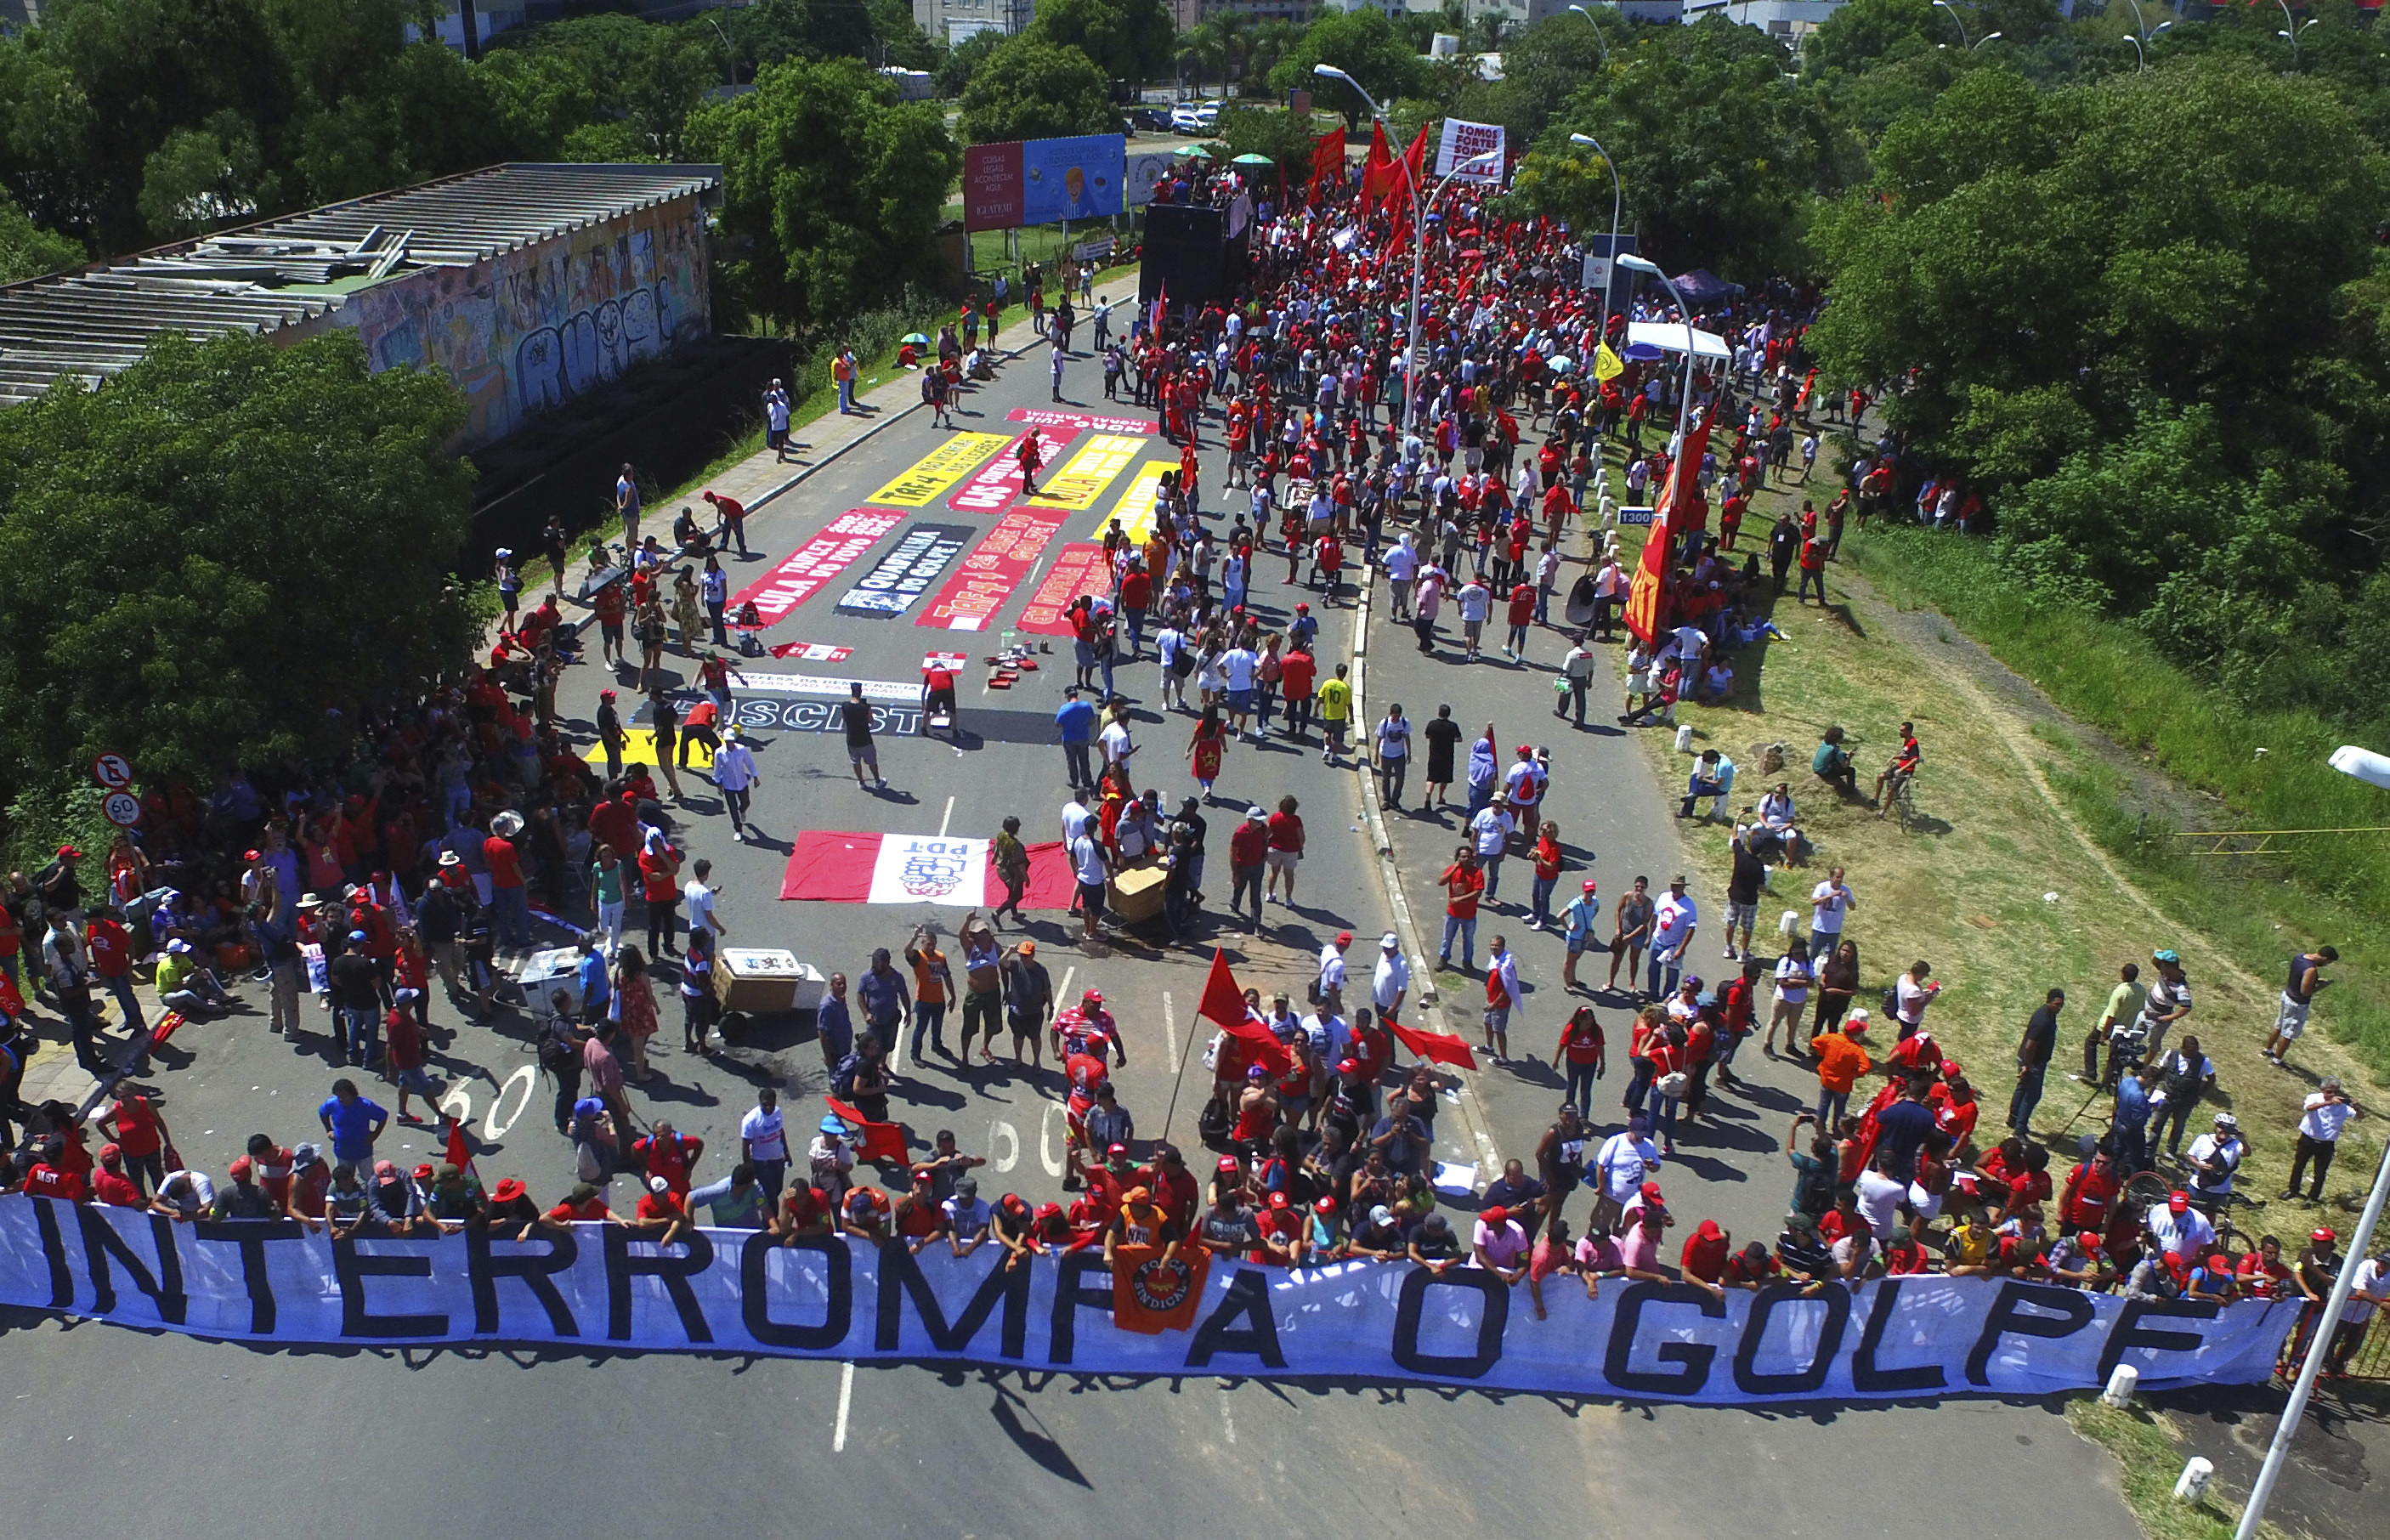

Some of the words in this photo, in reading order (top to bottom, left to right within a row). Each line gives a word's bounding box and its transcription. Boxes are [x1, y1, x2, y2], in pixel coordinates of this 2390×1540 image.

[1458, 124, 1498, 139] SOMOS
[1455, 134, 1497, 149] FORTES
[982, 155, 1005, 164] COISAS
[983, 164, 1004, 173] LEGAIS
[974, 173, 1013, 184] ACONTECEM
[1026, 410, 1082, 421] PARCIAL
[1092, 416, 1147, 427] IMORAL
[1073, 420, 1146, 434] MORO
[957, 485, 1011, 507] UJS
[1622, 512, 1650, 523] 1300
[808, 563, 841, 577] DO
[829, 539, 871, 562] POVO
[862, 532, 938, 588] QUADRILHA
[896, 578, 928, 592] DO
[1034, 565, 1085, 606] DEFESA
[754, 580, 817, 613] LULA
[1328, 688, 1341, 705] 10
[111, 799, 133, 812] 60
[903, 841, 968, 855] PDT
[434, 1065, 535, 1140] 60
[37, 1169, 59, 1184] MST
[1135, 1282, 1187, 1309] SINDICAL
[1391, 1265, 1509, 1379] O
